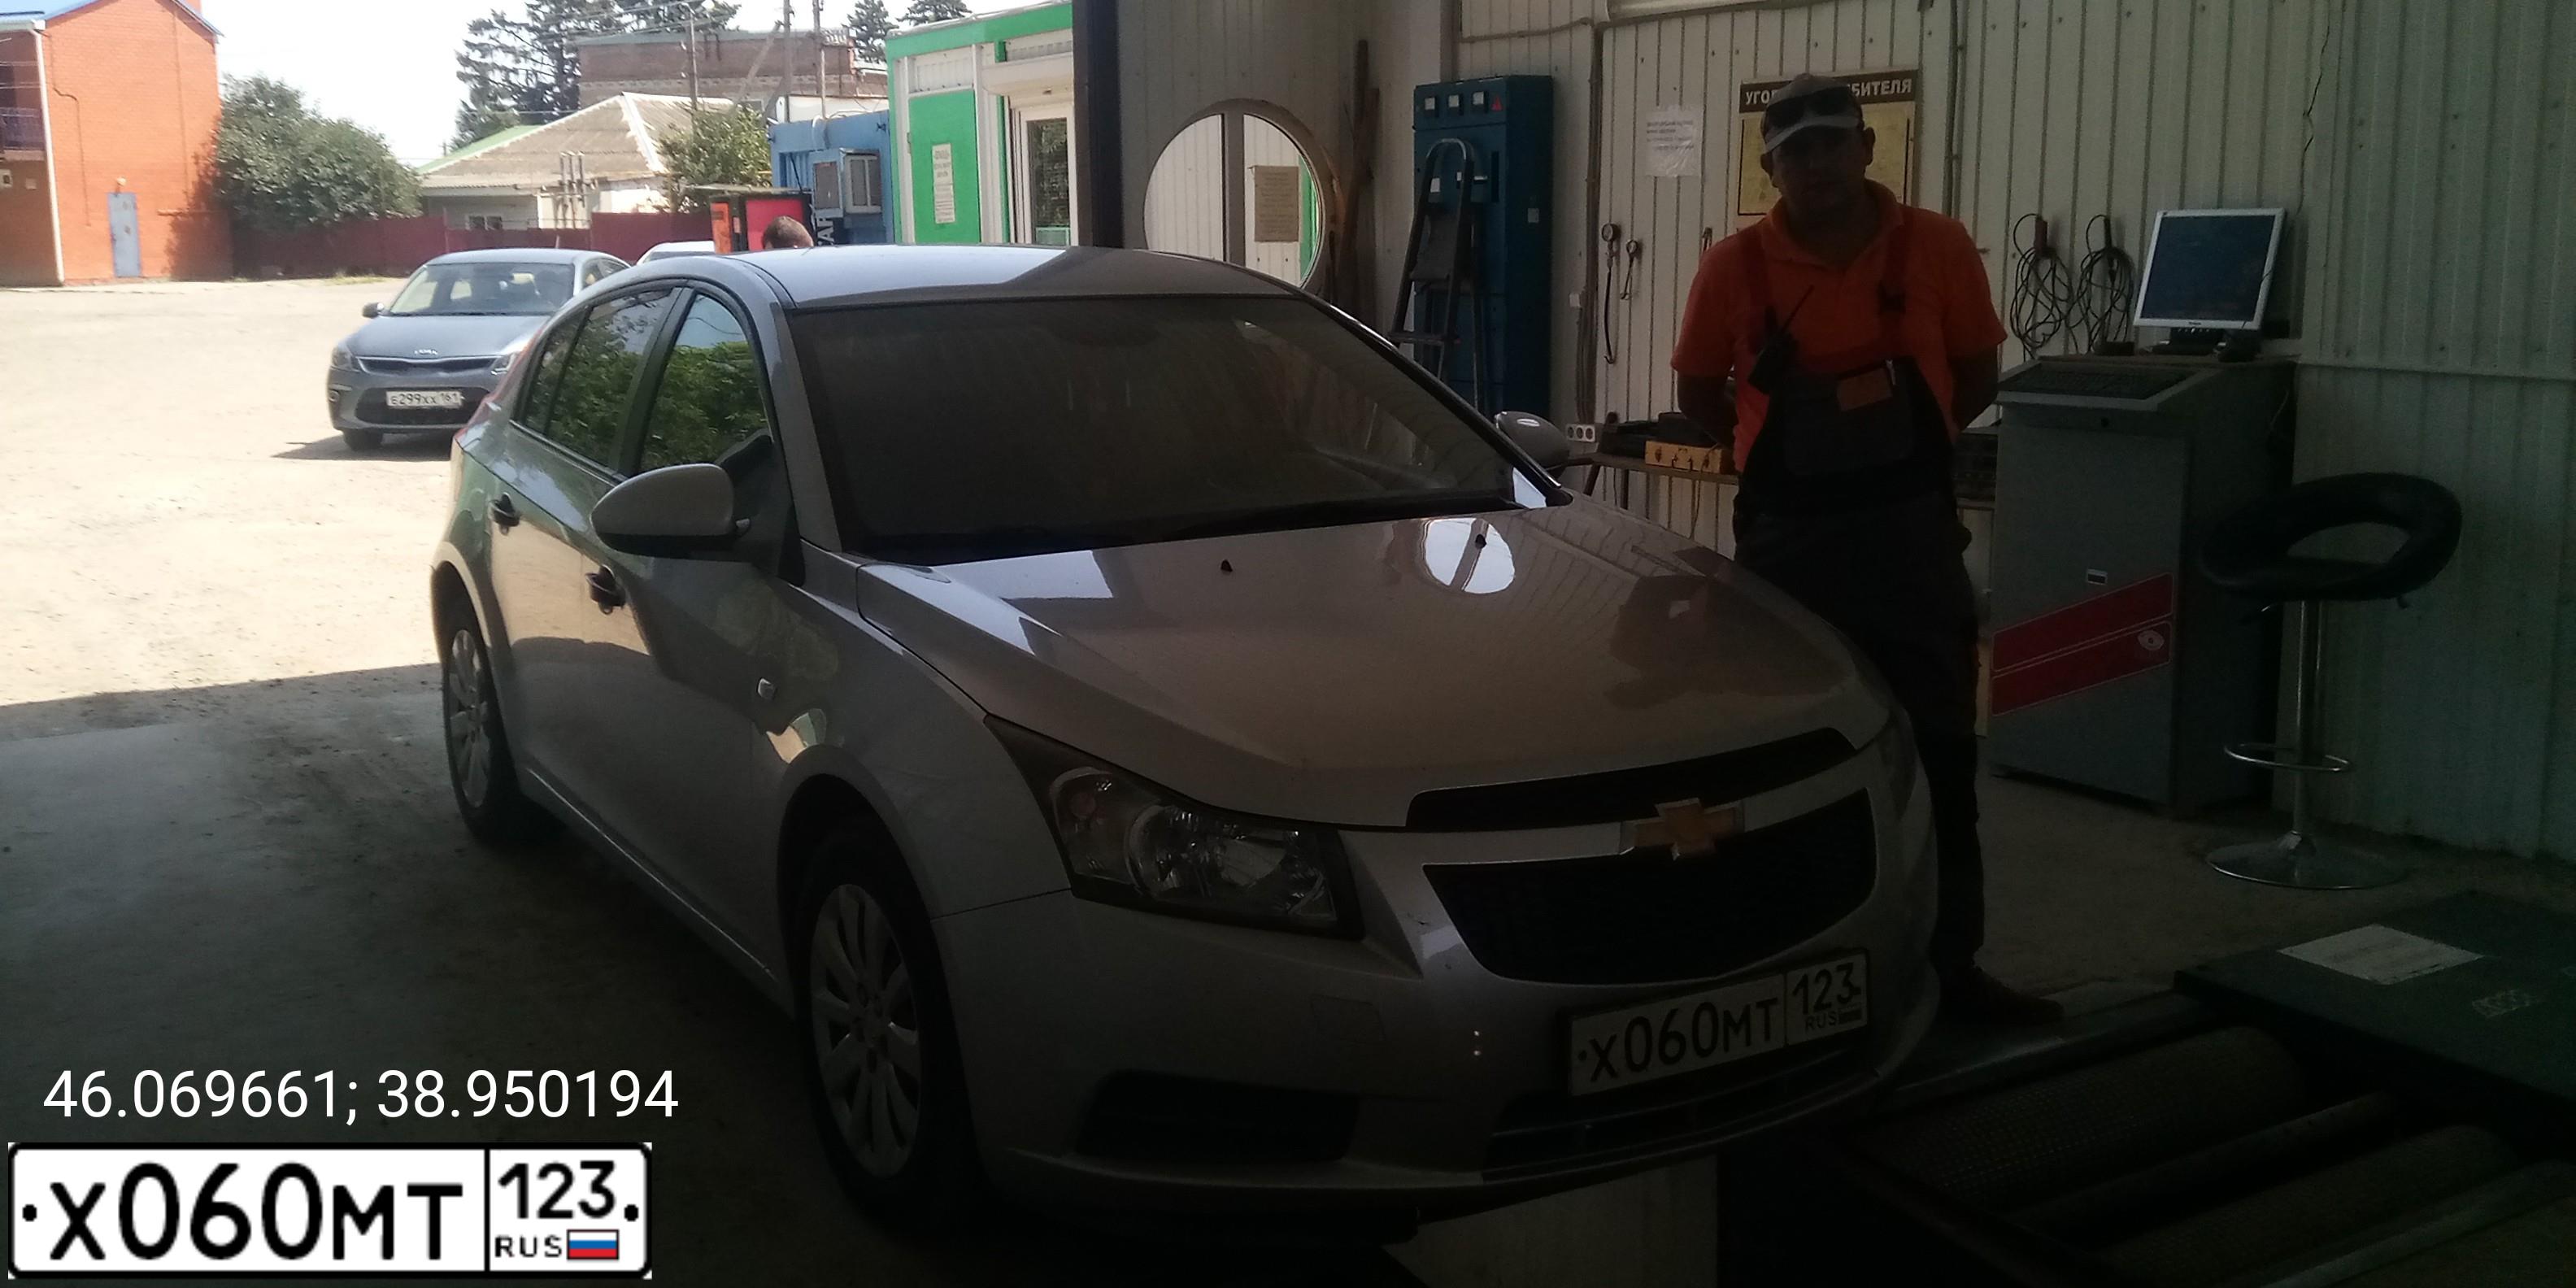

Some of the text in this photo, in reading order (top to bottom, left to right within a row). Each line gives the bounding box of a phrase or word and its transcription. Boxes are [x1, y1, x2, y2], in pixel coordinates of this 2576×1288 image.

[1745, 78, 1913, 106] УГО БИТЕЛЯ
[1590, 962, 1855, 1081] Х060МТ 123
[1804, 1011, 1838, 1032] RUS
